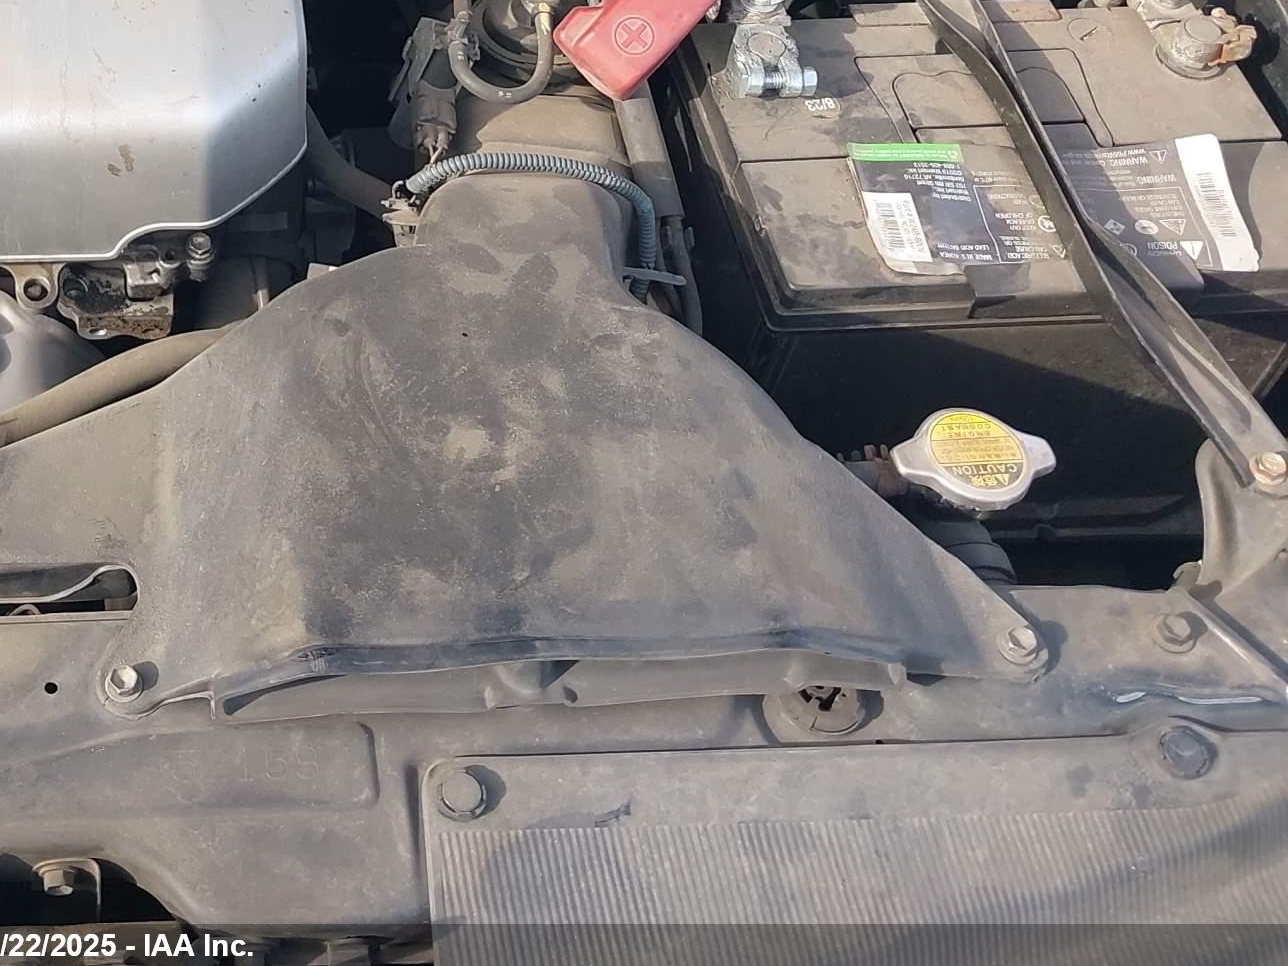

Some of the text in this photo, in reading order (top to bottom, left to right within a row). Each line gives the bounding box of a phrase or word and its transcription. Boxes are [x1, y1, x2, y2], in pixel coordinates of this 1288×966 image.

[804, 97, 835, 111] 8/23
[975, 243, 990, 251] LEAD
[1147, 241, 1178, 251] POISON
[951, 463, 1018, 475] CAUTION
